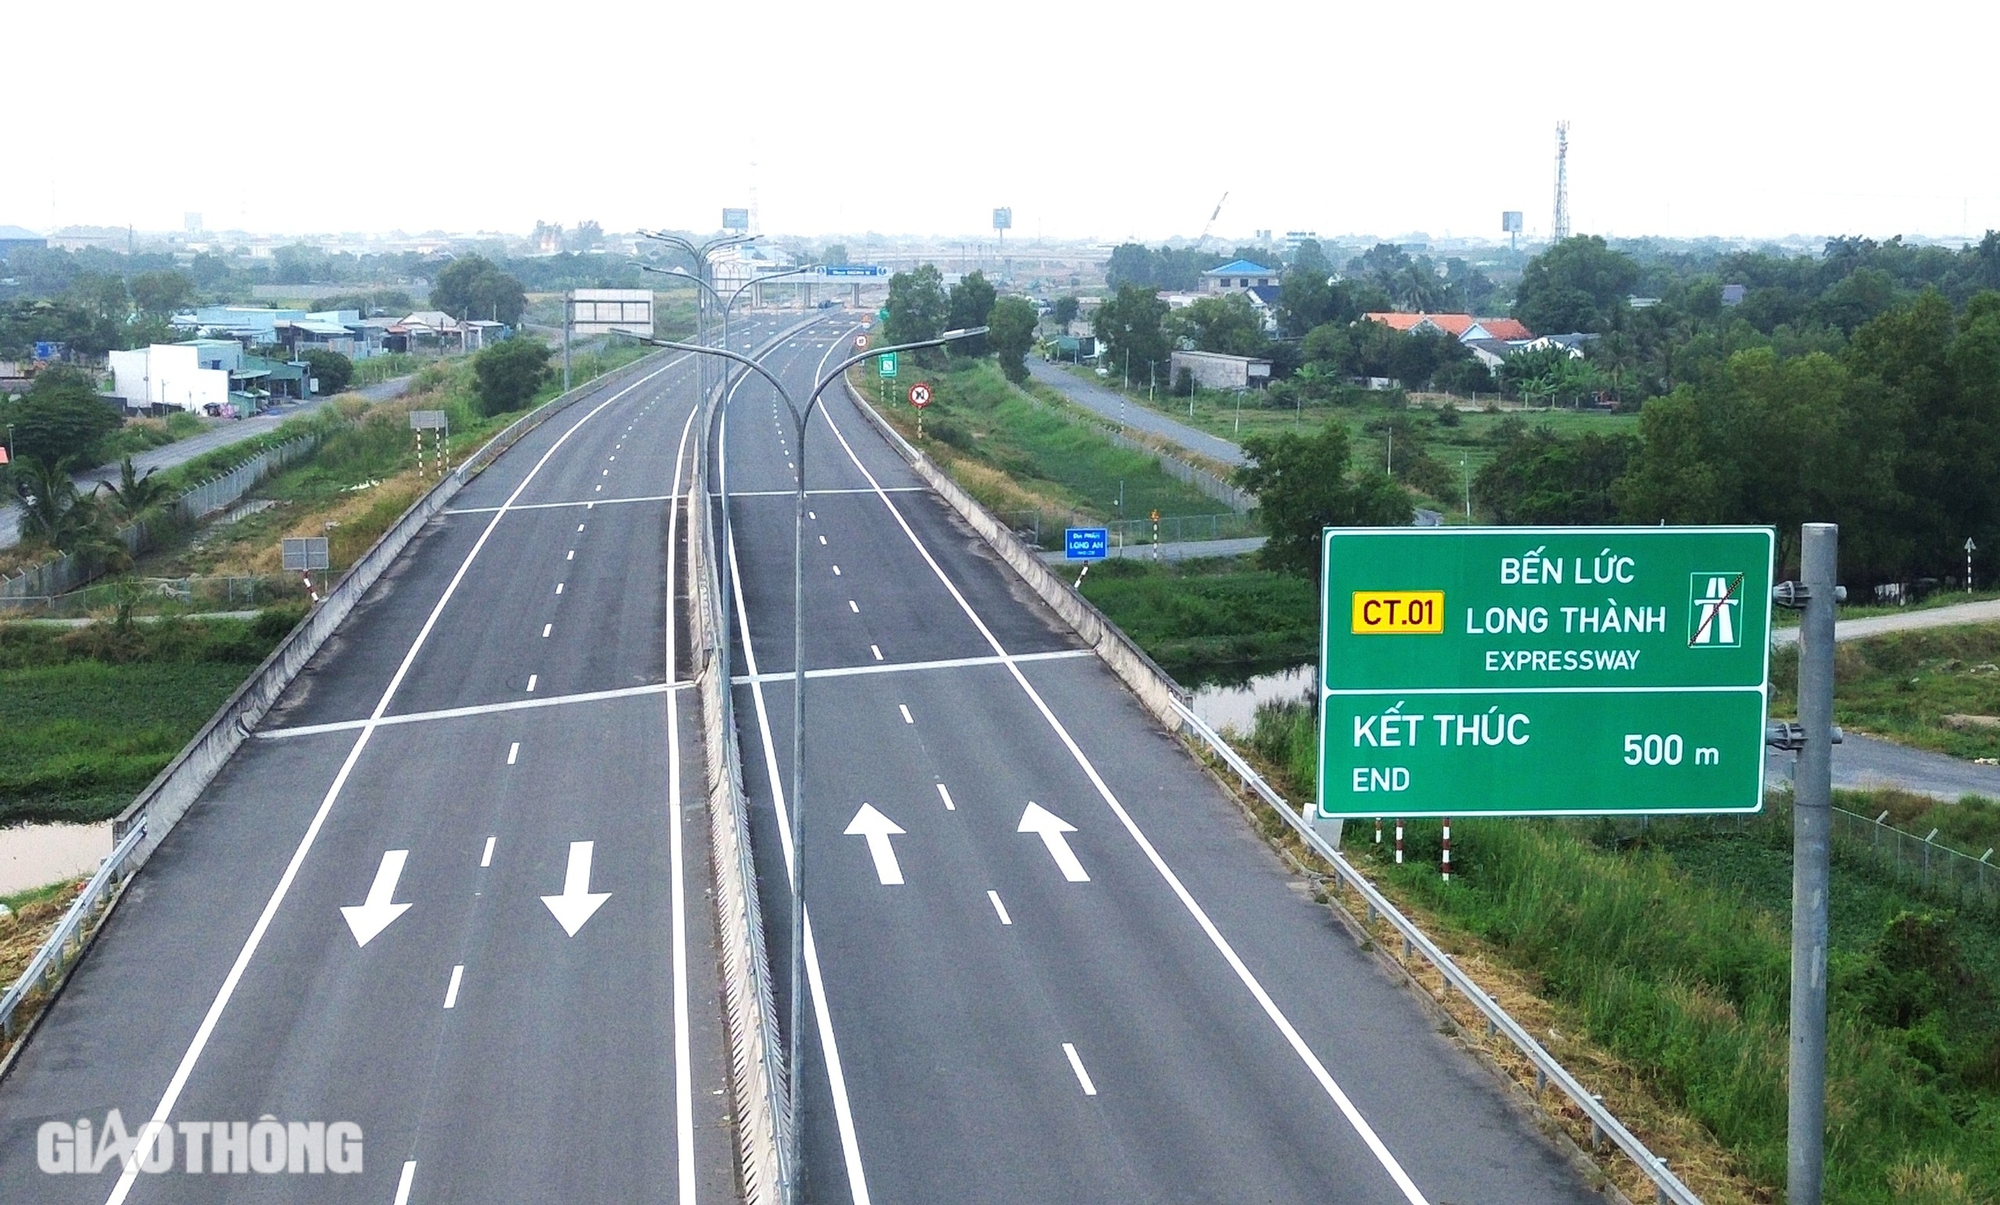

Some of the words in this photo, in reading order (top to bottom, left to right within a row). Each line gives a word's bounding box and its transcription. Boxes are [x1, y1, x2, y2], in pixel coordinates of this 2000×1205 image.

[1069, 541, 1090, 549] LONG
[1091, 541, 1104, 549] AN
[1500, 545, 1563, 584] BẾN
[1574, 547, 1635, 584] LỨC
[1363, 599, 1433, 626] CT.01
[1466, 606, 1548, 634] LONG
[1560, 598, 1666, 633] THÀNH
[1485, 649, 1641, 671] EXPRESSWAY
[1352, 700, 1424, 747] KẾT
[1432, 705, 1530, 746] THÚC
[1623, 734, 1683, 766] 500
[1694, 747, 1720, 765] m
[1352, 767, 1410, 792] END
